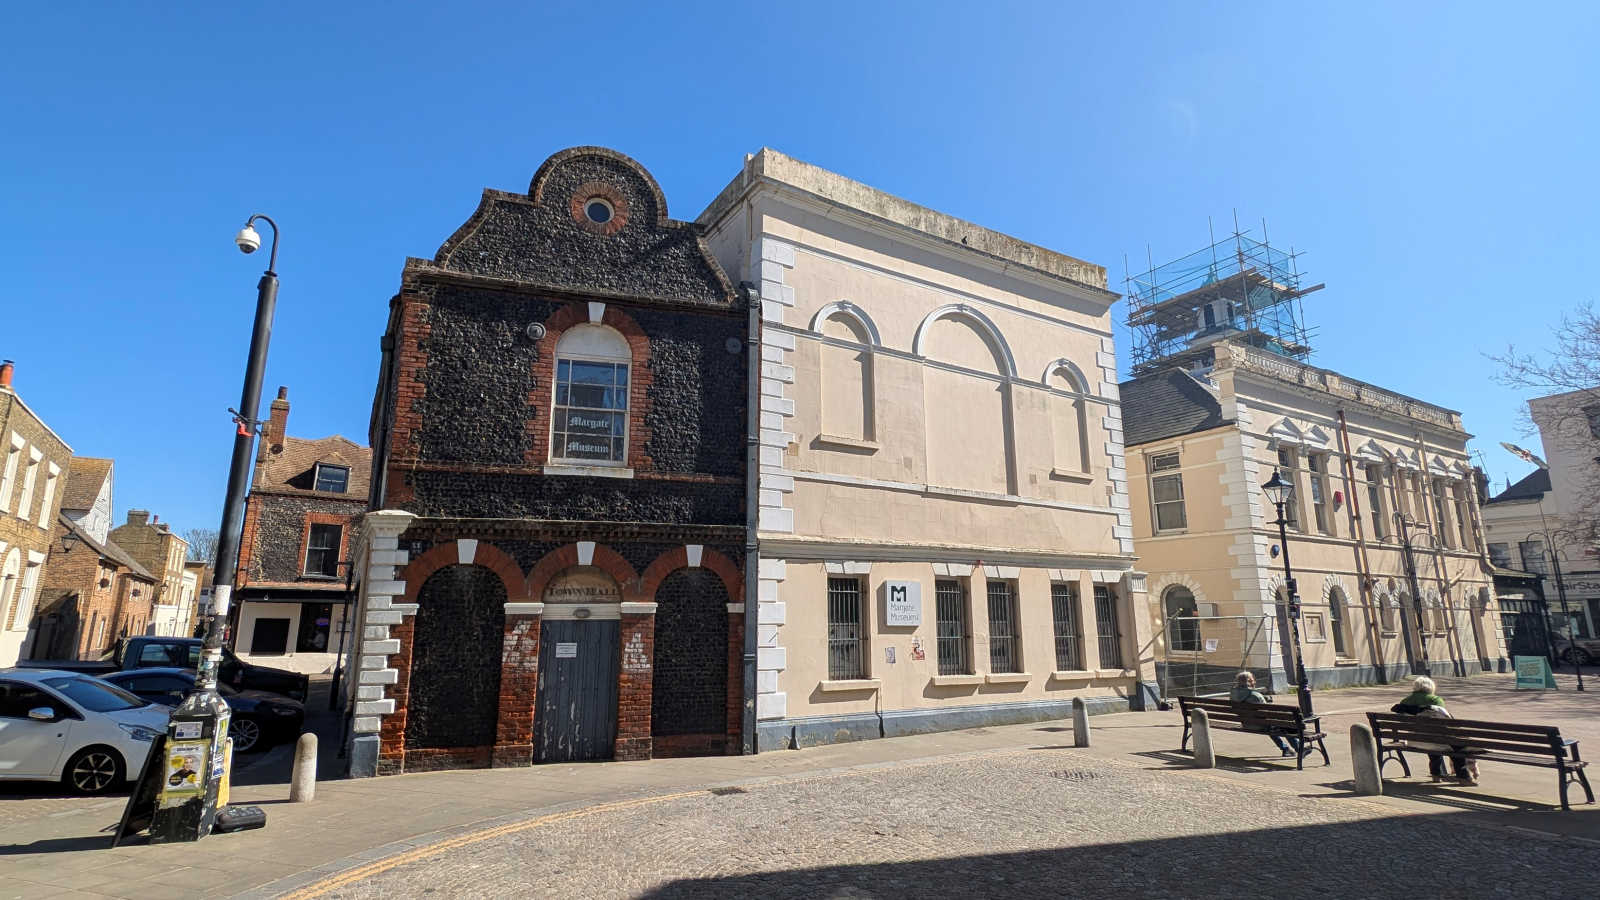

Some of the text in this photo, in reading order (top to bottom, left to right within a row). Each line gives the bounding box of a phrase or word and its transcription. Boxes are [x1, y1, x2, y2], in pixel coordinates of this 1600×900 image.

[569, 416, 608, 429] Margate
[568, 441, 608, 453] Museum
[890, 602, 915, 613] Margate
[890, 613, 919, 621] Museum
